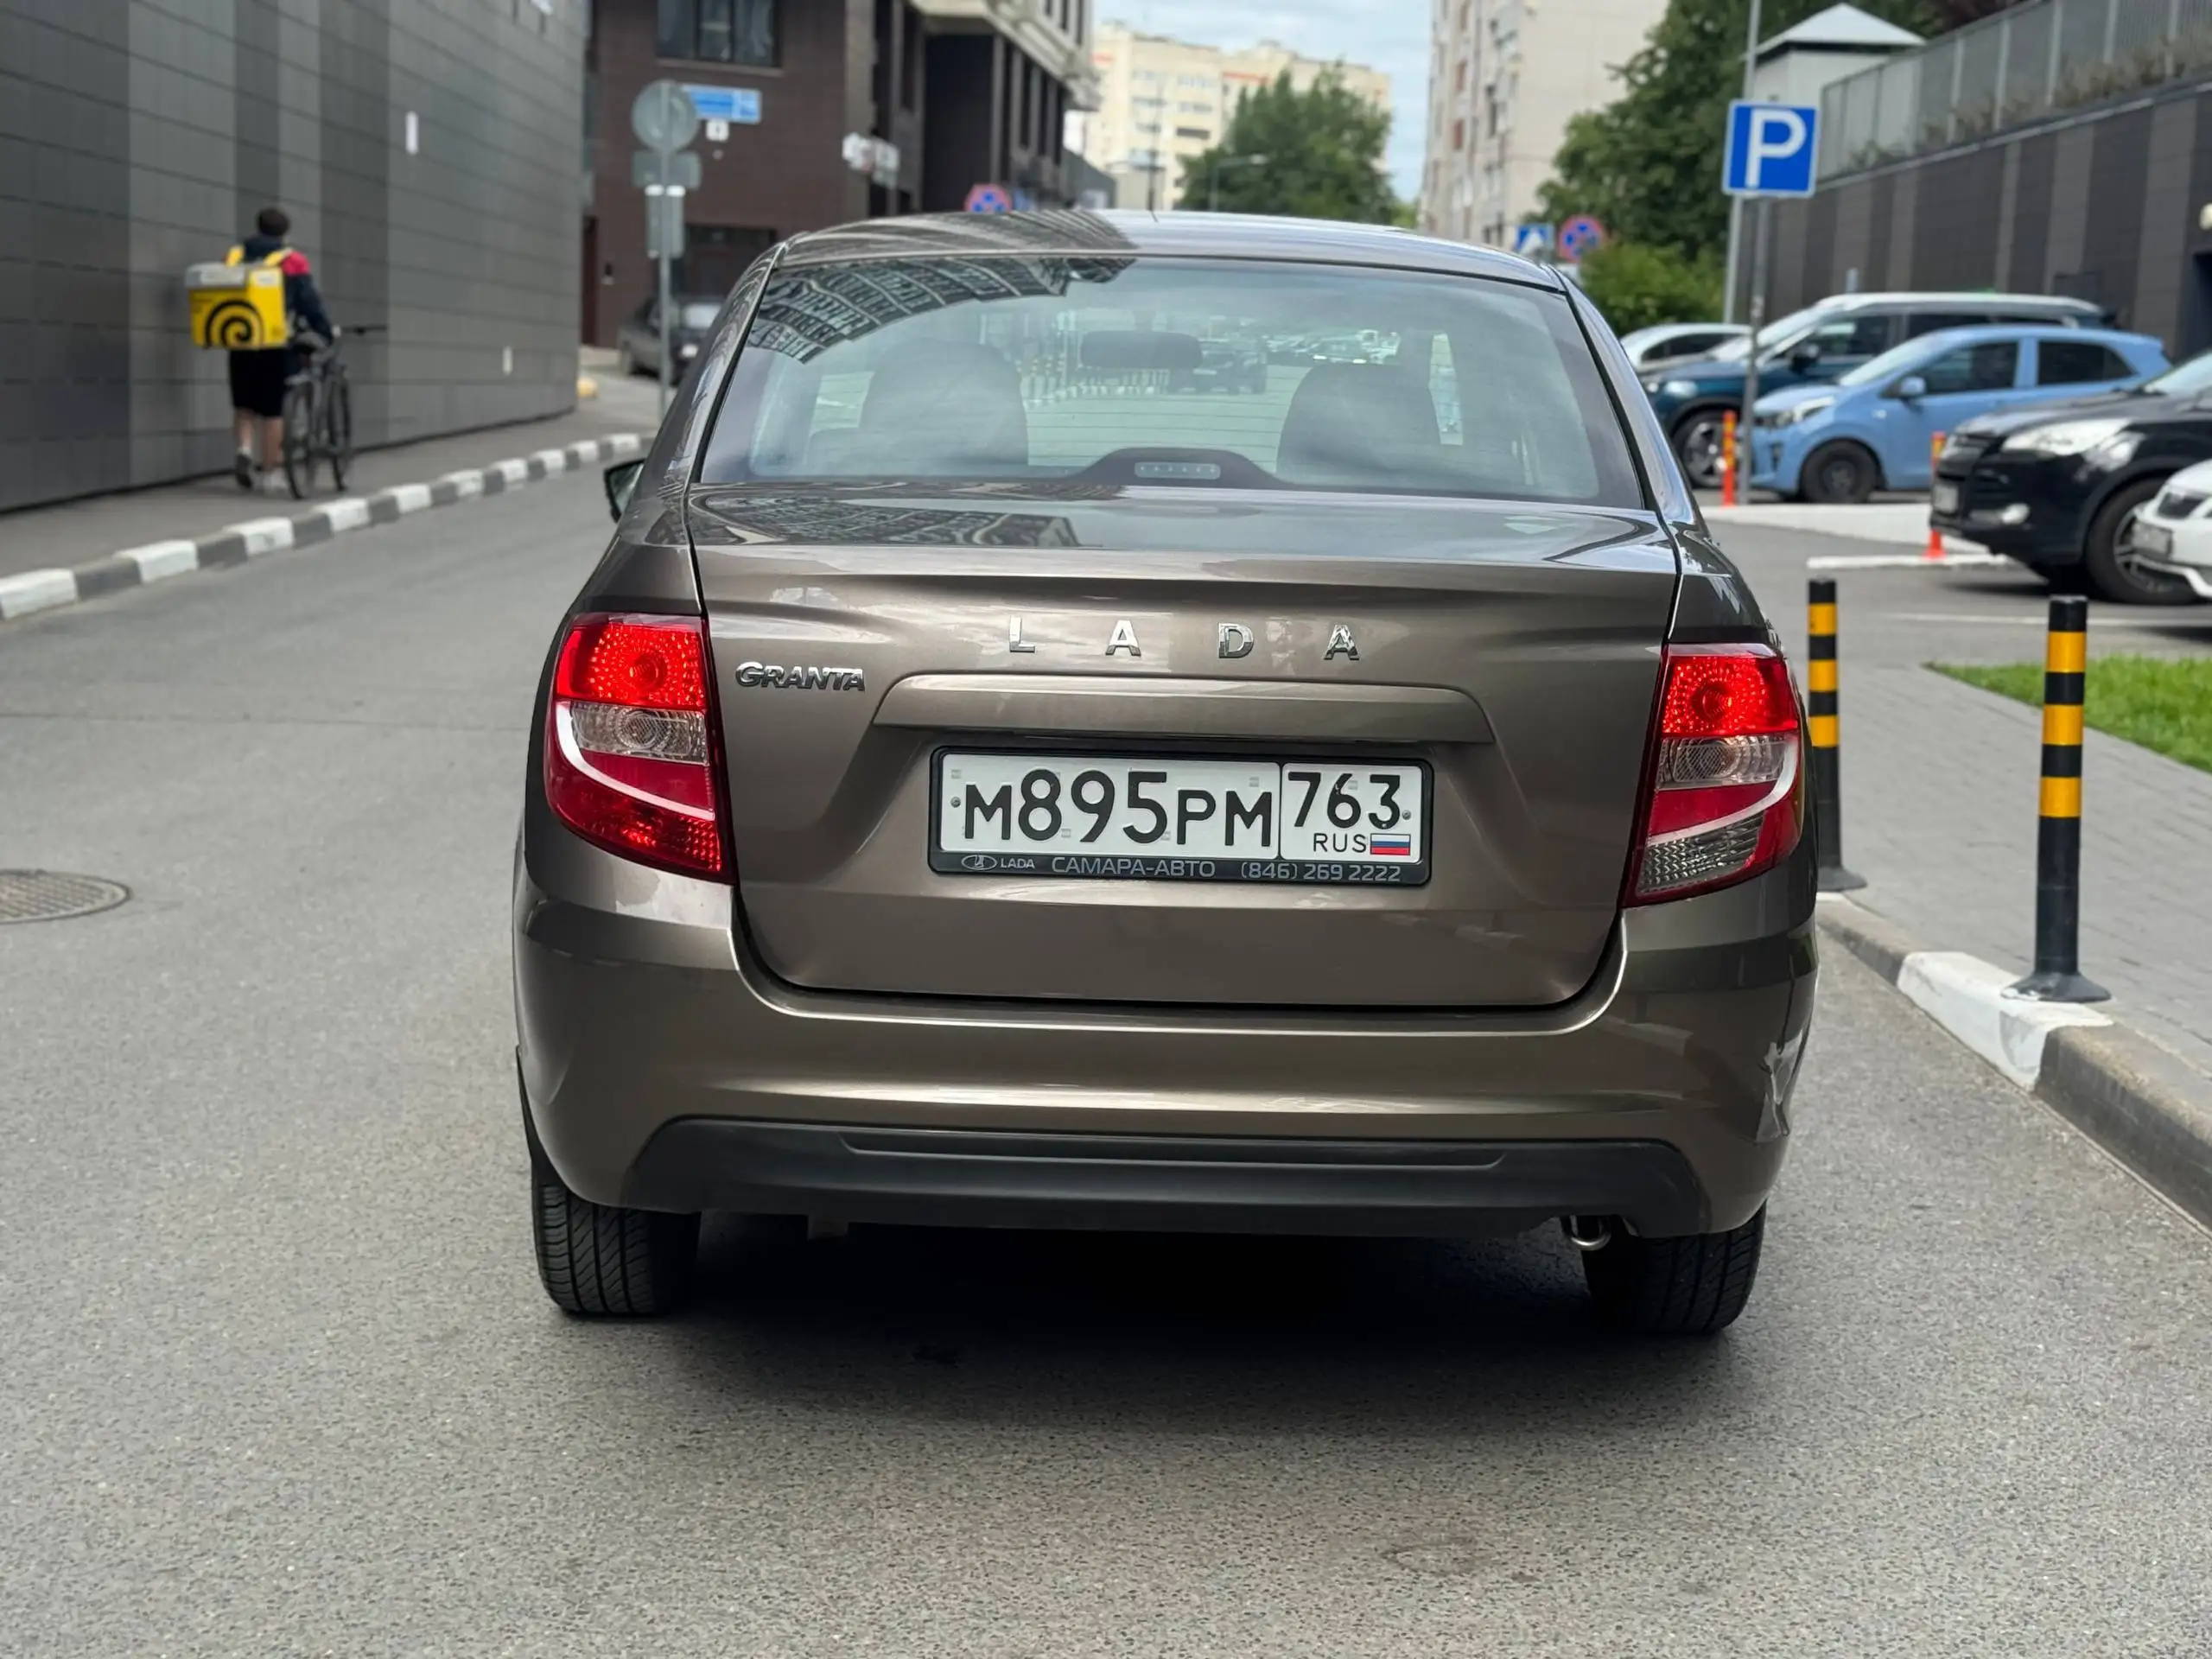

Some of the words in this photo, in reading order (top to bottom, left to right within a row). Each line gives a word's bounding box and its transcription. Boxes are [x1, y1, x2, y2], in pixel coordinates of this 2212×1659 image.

[1745, 109, 1808, 188] P
[1009, 616, 1359, 660] LADA
[735, 661, 865, 691] GRANTA
[1287, 772, 1402, 830] 763
[1313, 833, 1367, 853] RUS
[1000, 857, 1035, 869] LADA
[1052, 856, 1215, 878] САМАРА-АВТО
[1241, 863, 1297, 880] (846)
[1303, 864, 1343, 880] 269
[1348, 865, 1401, 881] 2222
